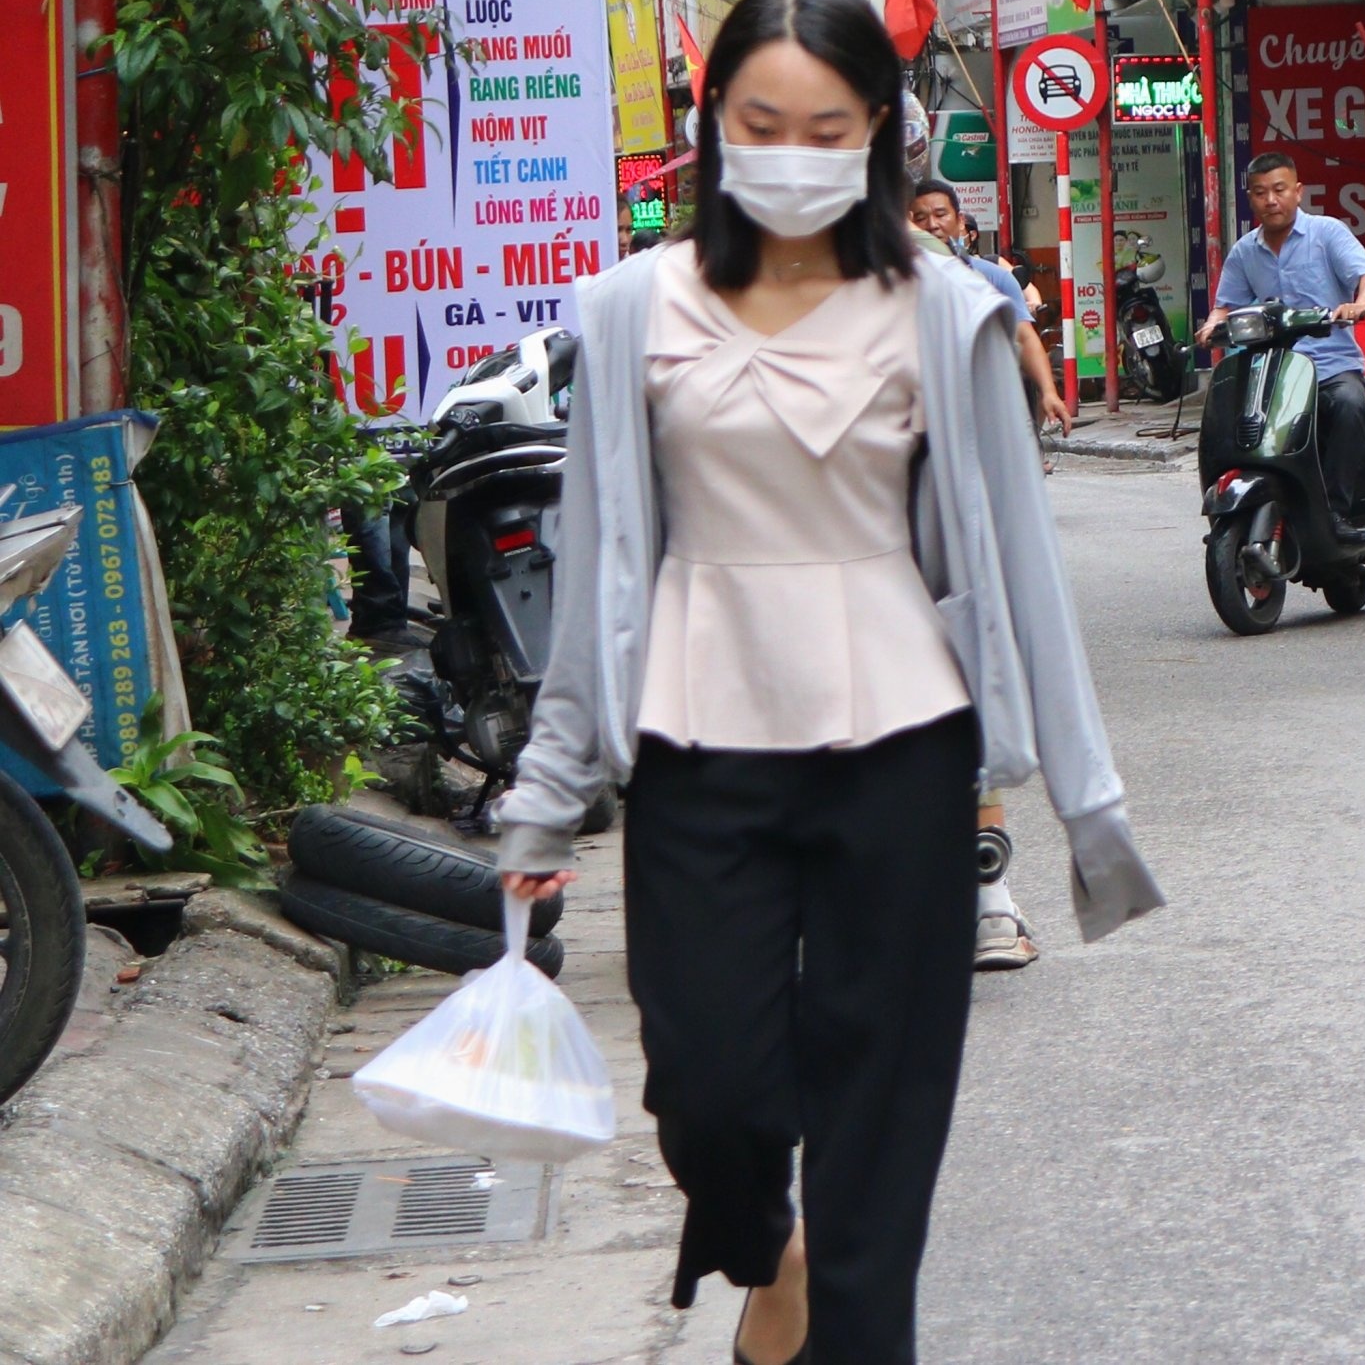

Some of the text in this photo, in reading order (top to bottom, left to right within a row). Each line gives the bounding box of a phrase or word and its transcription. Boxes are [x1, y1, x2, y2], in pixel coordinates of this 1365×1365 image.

[524, 25, 572, 60] MUỐI
[470, 66, 582, 102] RANG RIỀNG
[1118, 72, 1203, 106] NHÀ THUỐC
[1132, 101, 1192, 120] NGỌC LÝ
[1261, 87, 1323, 143] XE
[471, 113, 548, 148] NỘM VỊT
[474, 151, 568, 185] TIẾT CANH
[475, 197, 524, 226] LÒNG
[529, 189, 558, 223] MỀ
[564, 192, 601, 221] XÀO
[963, 195, 994, 205] MOTOR
[386, 238, 464, 293] BÚN
[503, 227, 601, 287] MIẾN
[445, 298, 561, 328] GÀ VỊT
[98, 490, 117, 538] 072
[103, 541, 124, 600] 0967
[68, 603, 86, 636] NƠI
[70, 639, 94, 678] TẬN
[108, 619, 129, 662] 263
[113, 664, 135, 708] 289
